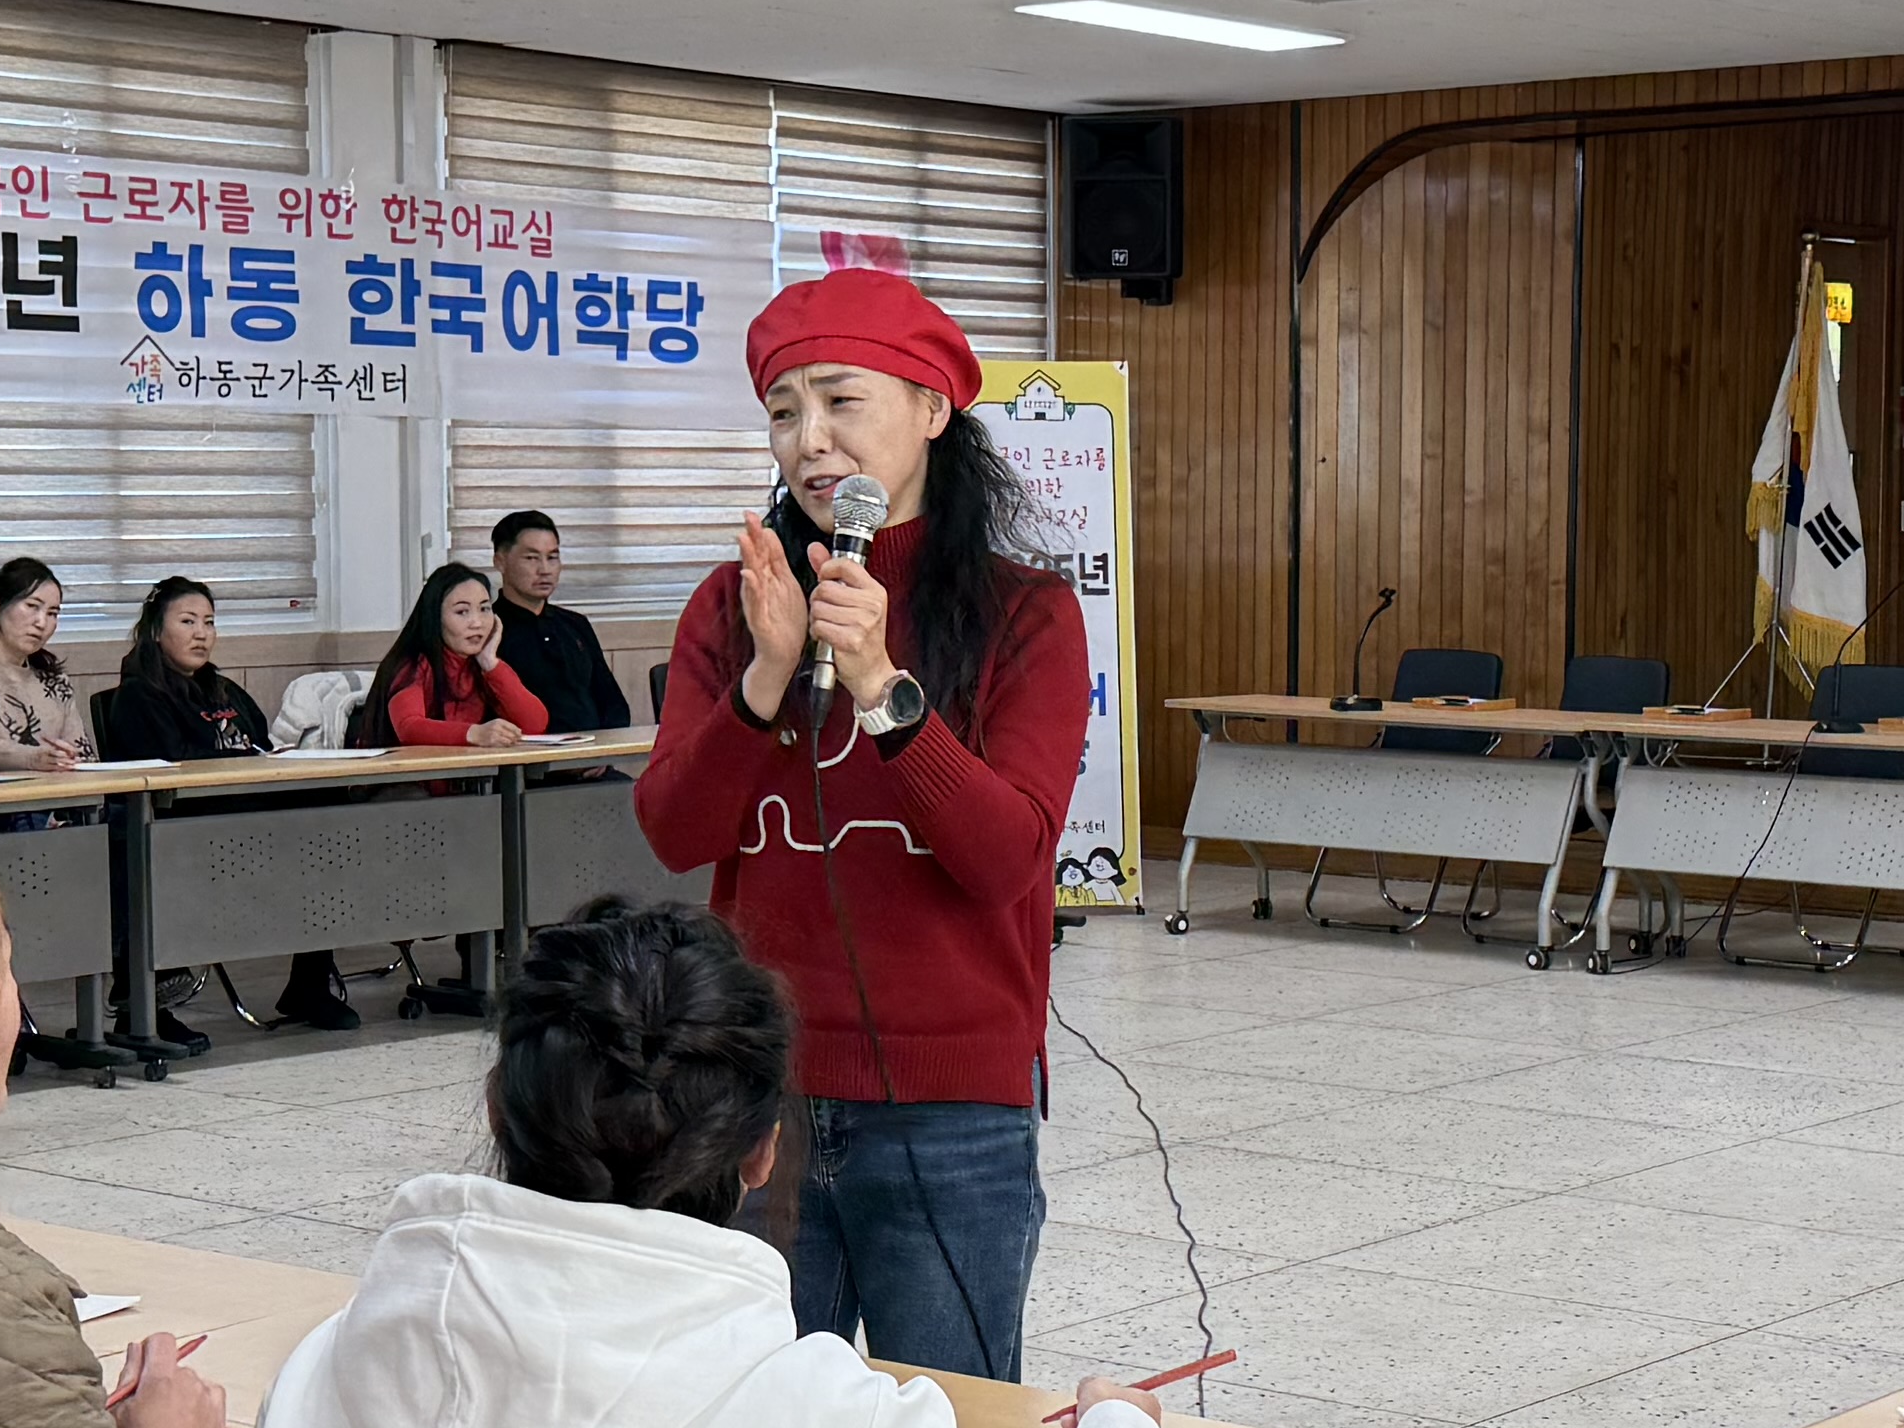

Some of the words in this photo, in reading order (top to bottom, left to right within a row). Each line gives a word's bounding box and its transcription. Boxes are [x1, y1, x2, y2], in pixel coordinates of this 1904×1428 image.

[77, 171, 256, 235] 근로자를
[277, 184, 358, 240] 위한
[382, 192, 555, 258] 한국어교실
[134, 241, 300, 342] 하동
[345, 253, 705, 364] 한국어학당
[126, 377, 163, 404] 센터
[128, 354, 161, 384] 가족
[174, 355, 408, 404] 하동군가족센터
